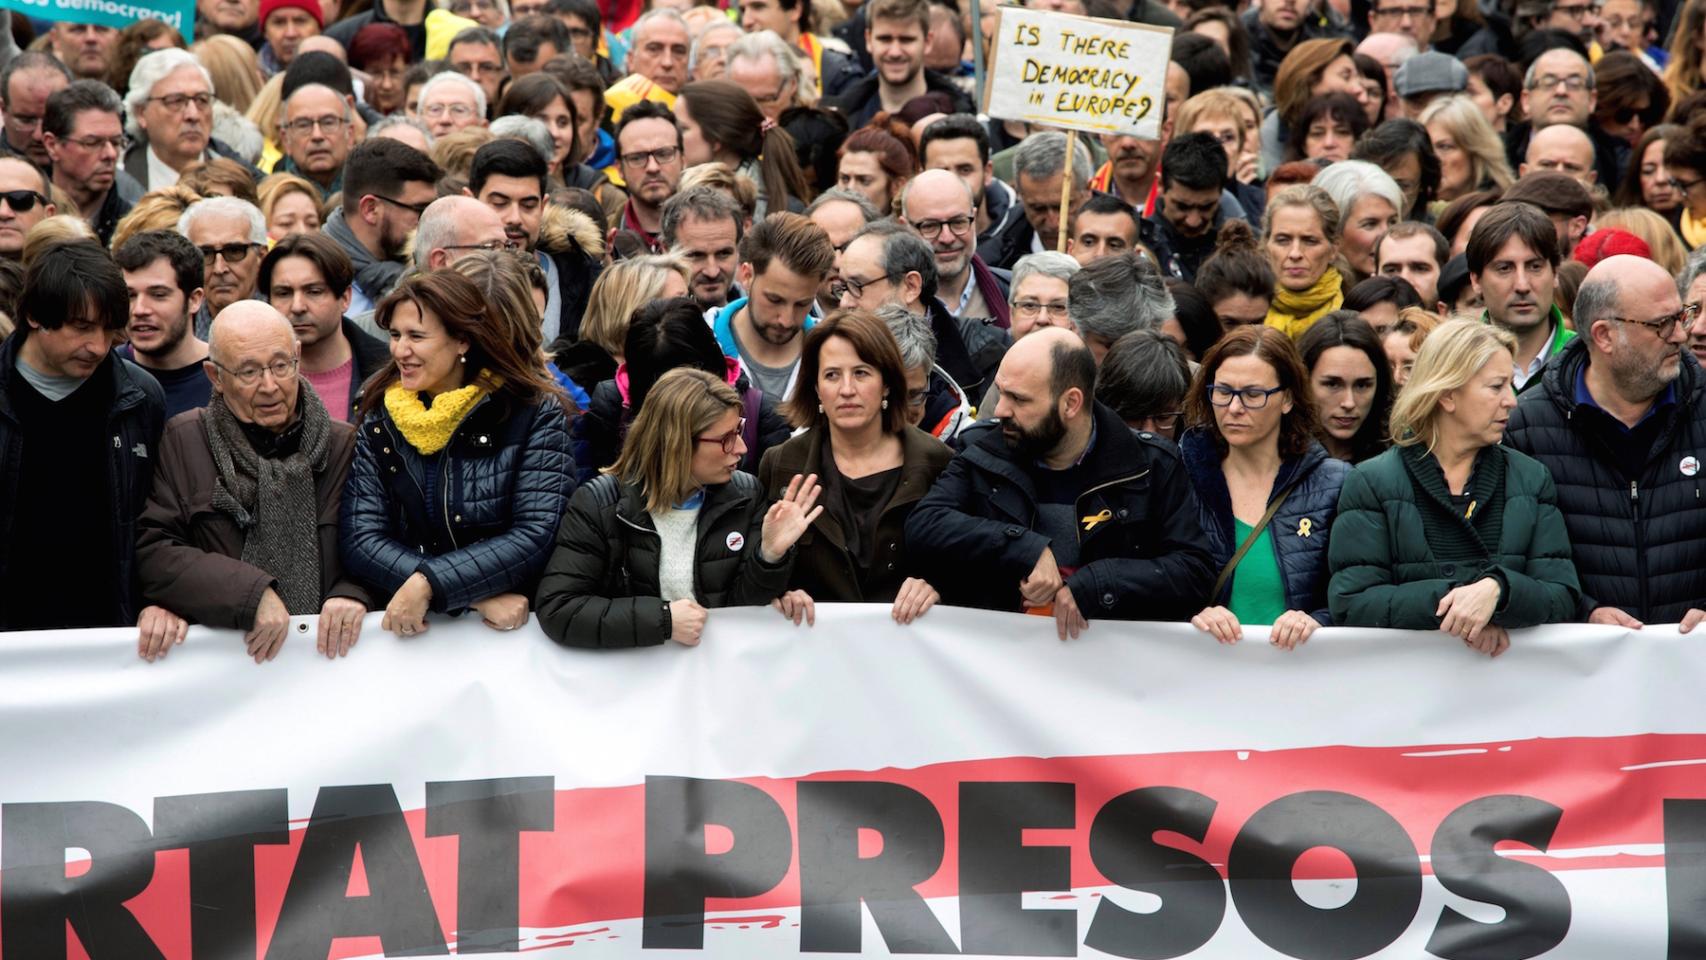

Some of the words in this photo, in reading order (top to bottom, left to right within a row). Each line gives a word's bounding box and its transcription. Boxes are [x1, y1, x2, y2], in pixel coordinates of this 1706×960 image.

[1014, 24, 1040, 46] IS
[1061, 32, 1131, 59] THERE
[1022, 58, 1140, 96] DEMOCRACY
[1056, 92, 1152, 125] EUROPE?
[1, 776, 555, 960] RTAT
[642, 775, 1572, 960] PRESOS
